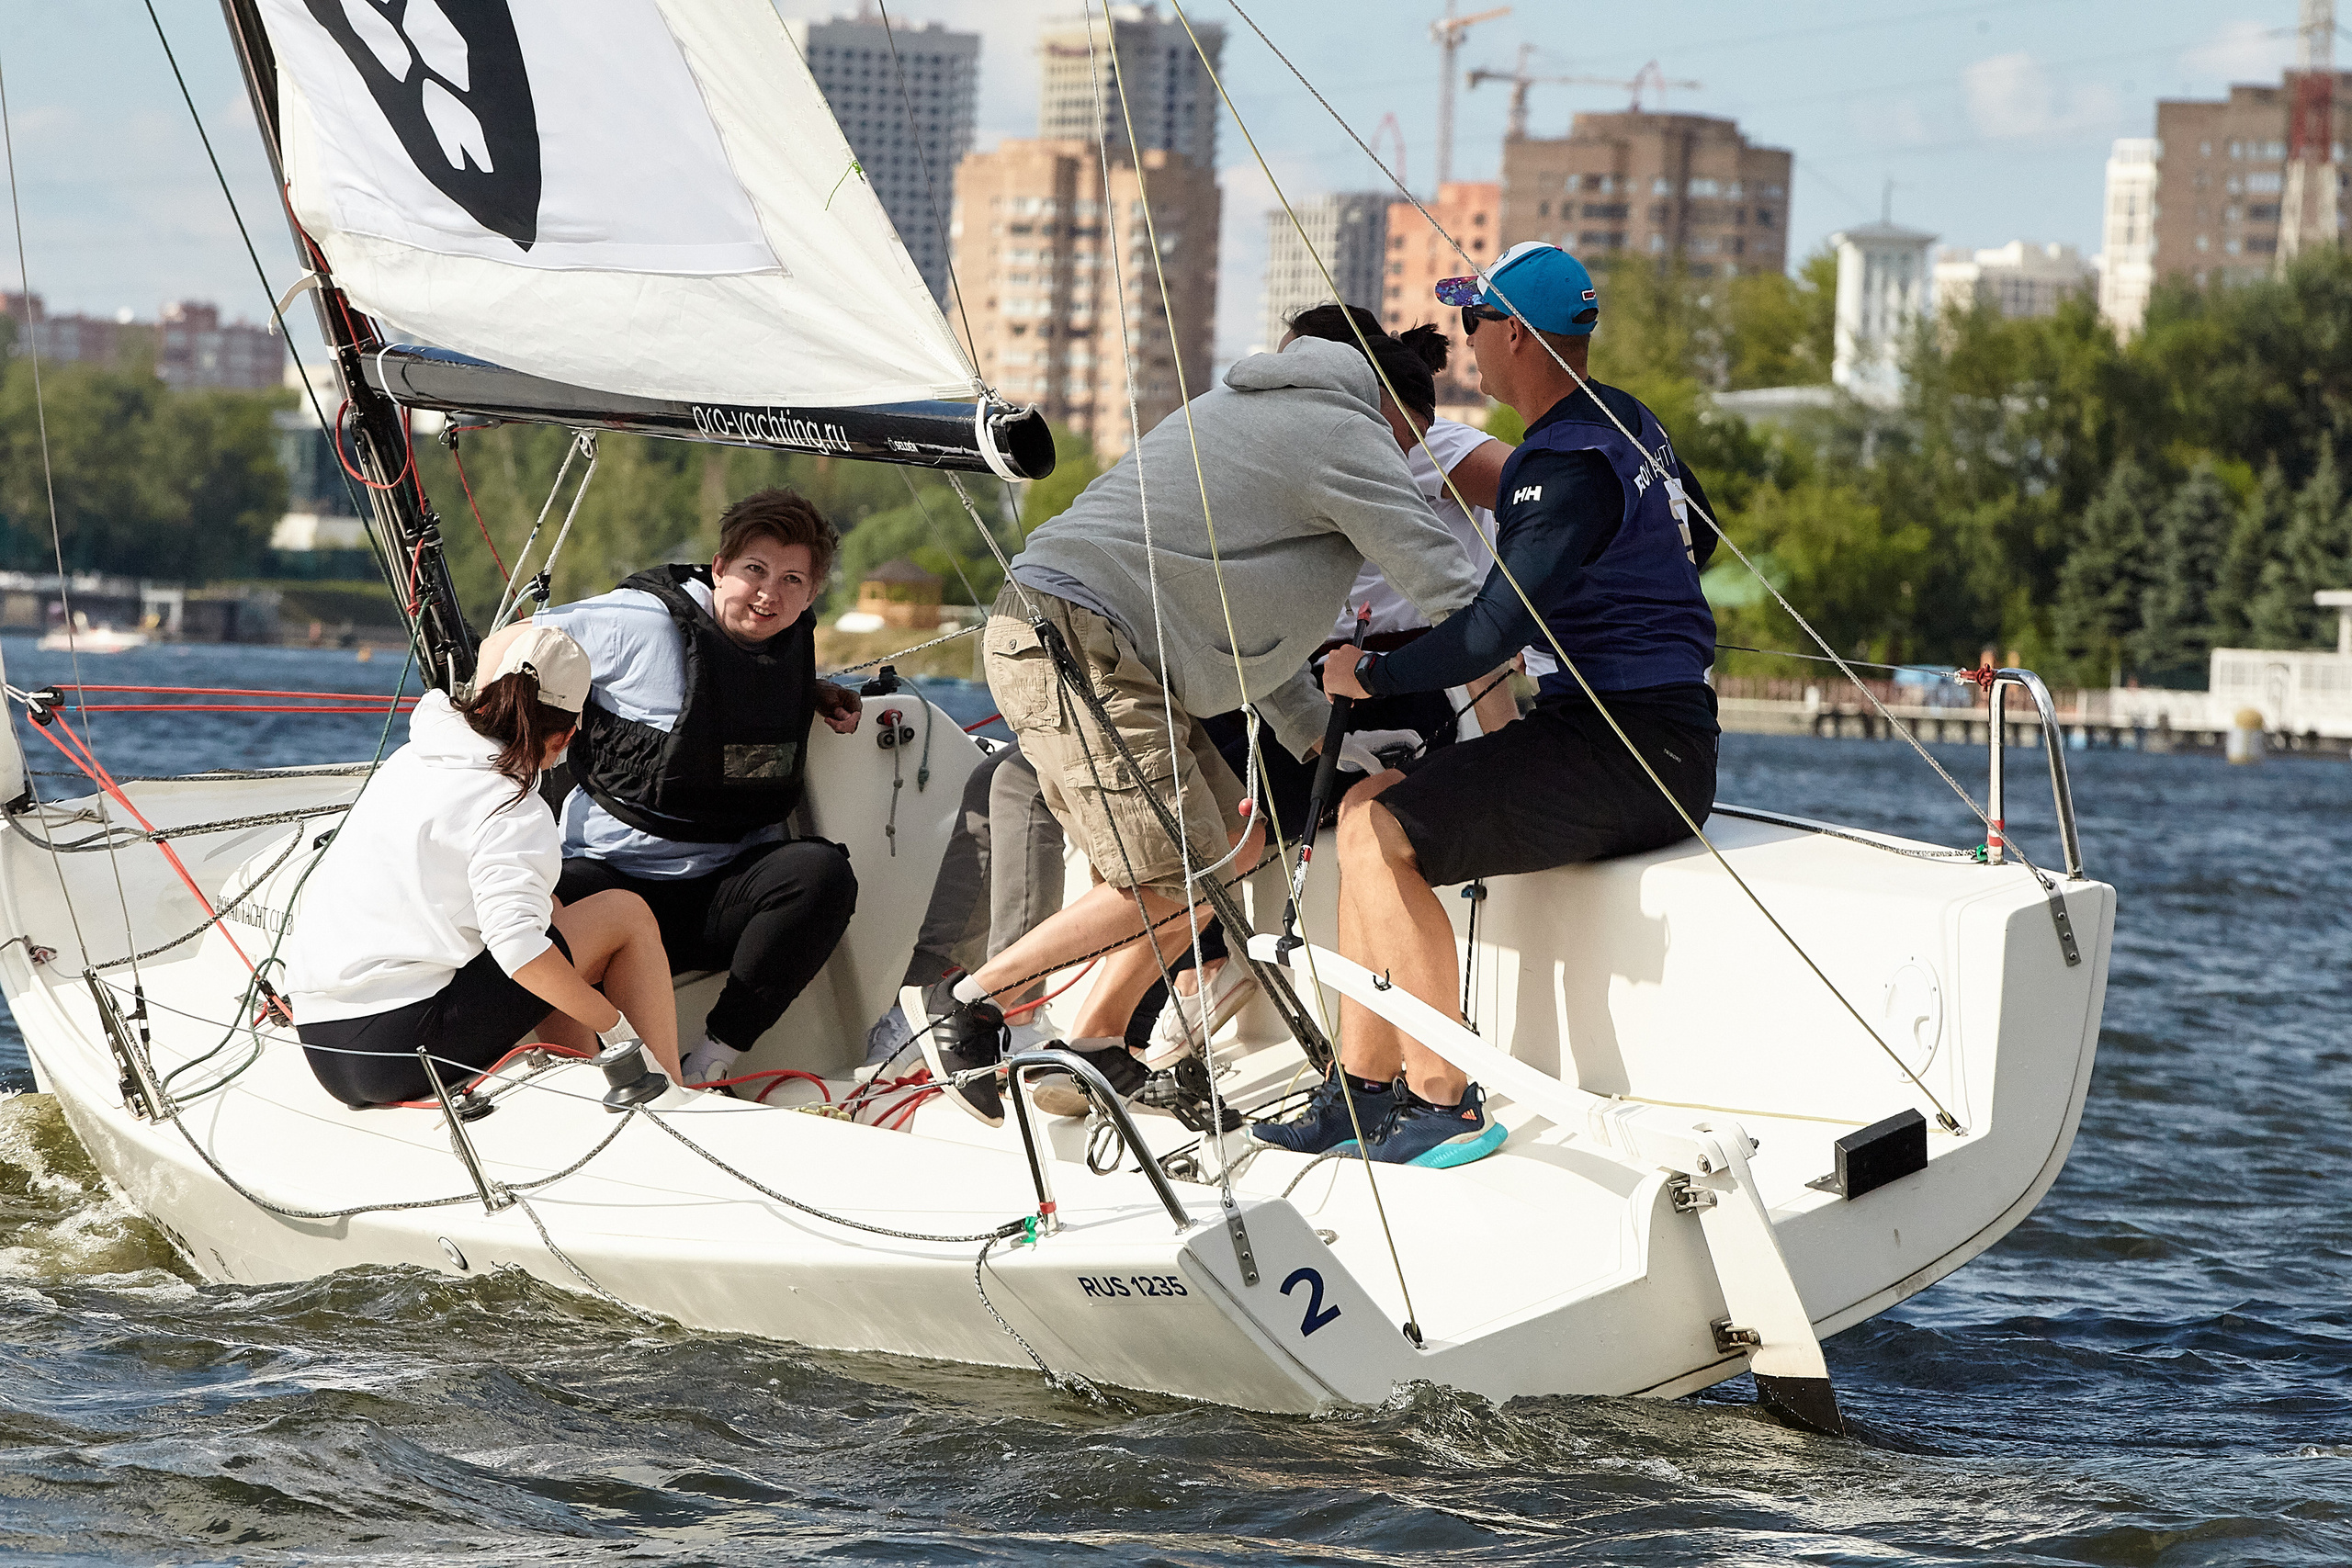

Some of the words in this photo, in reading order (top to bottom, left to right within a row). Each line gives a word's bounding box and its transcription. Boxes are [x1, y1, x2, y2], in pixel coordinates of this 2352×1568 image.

[692, 405, 853, 456] pro-yachting.ru
[1513, 485, 1542, 505] HH
[242, 901, 268, 930] YACHT
[1078, 1276, 1132, 1297] RUS
[1130, 1276, 1188, 1297] 1235
[1280, 1268, 1341, 1337] 2
